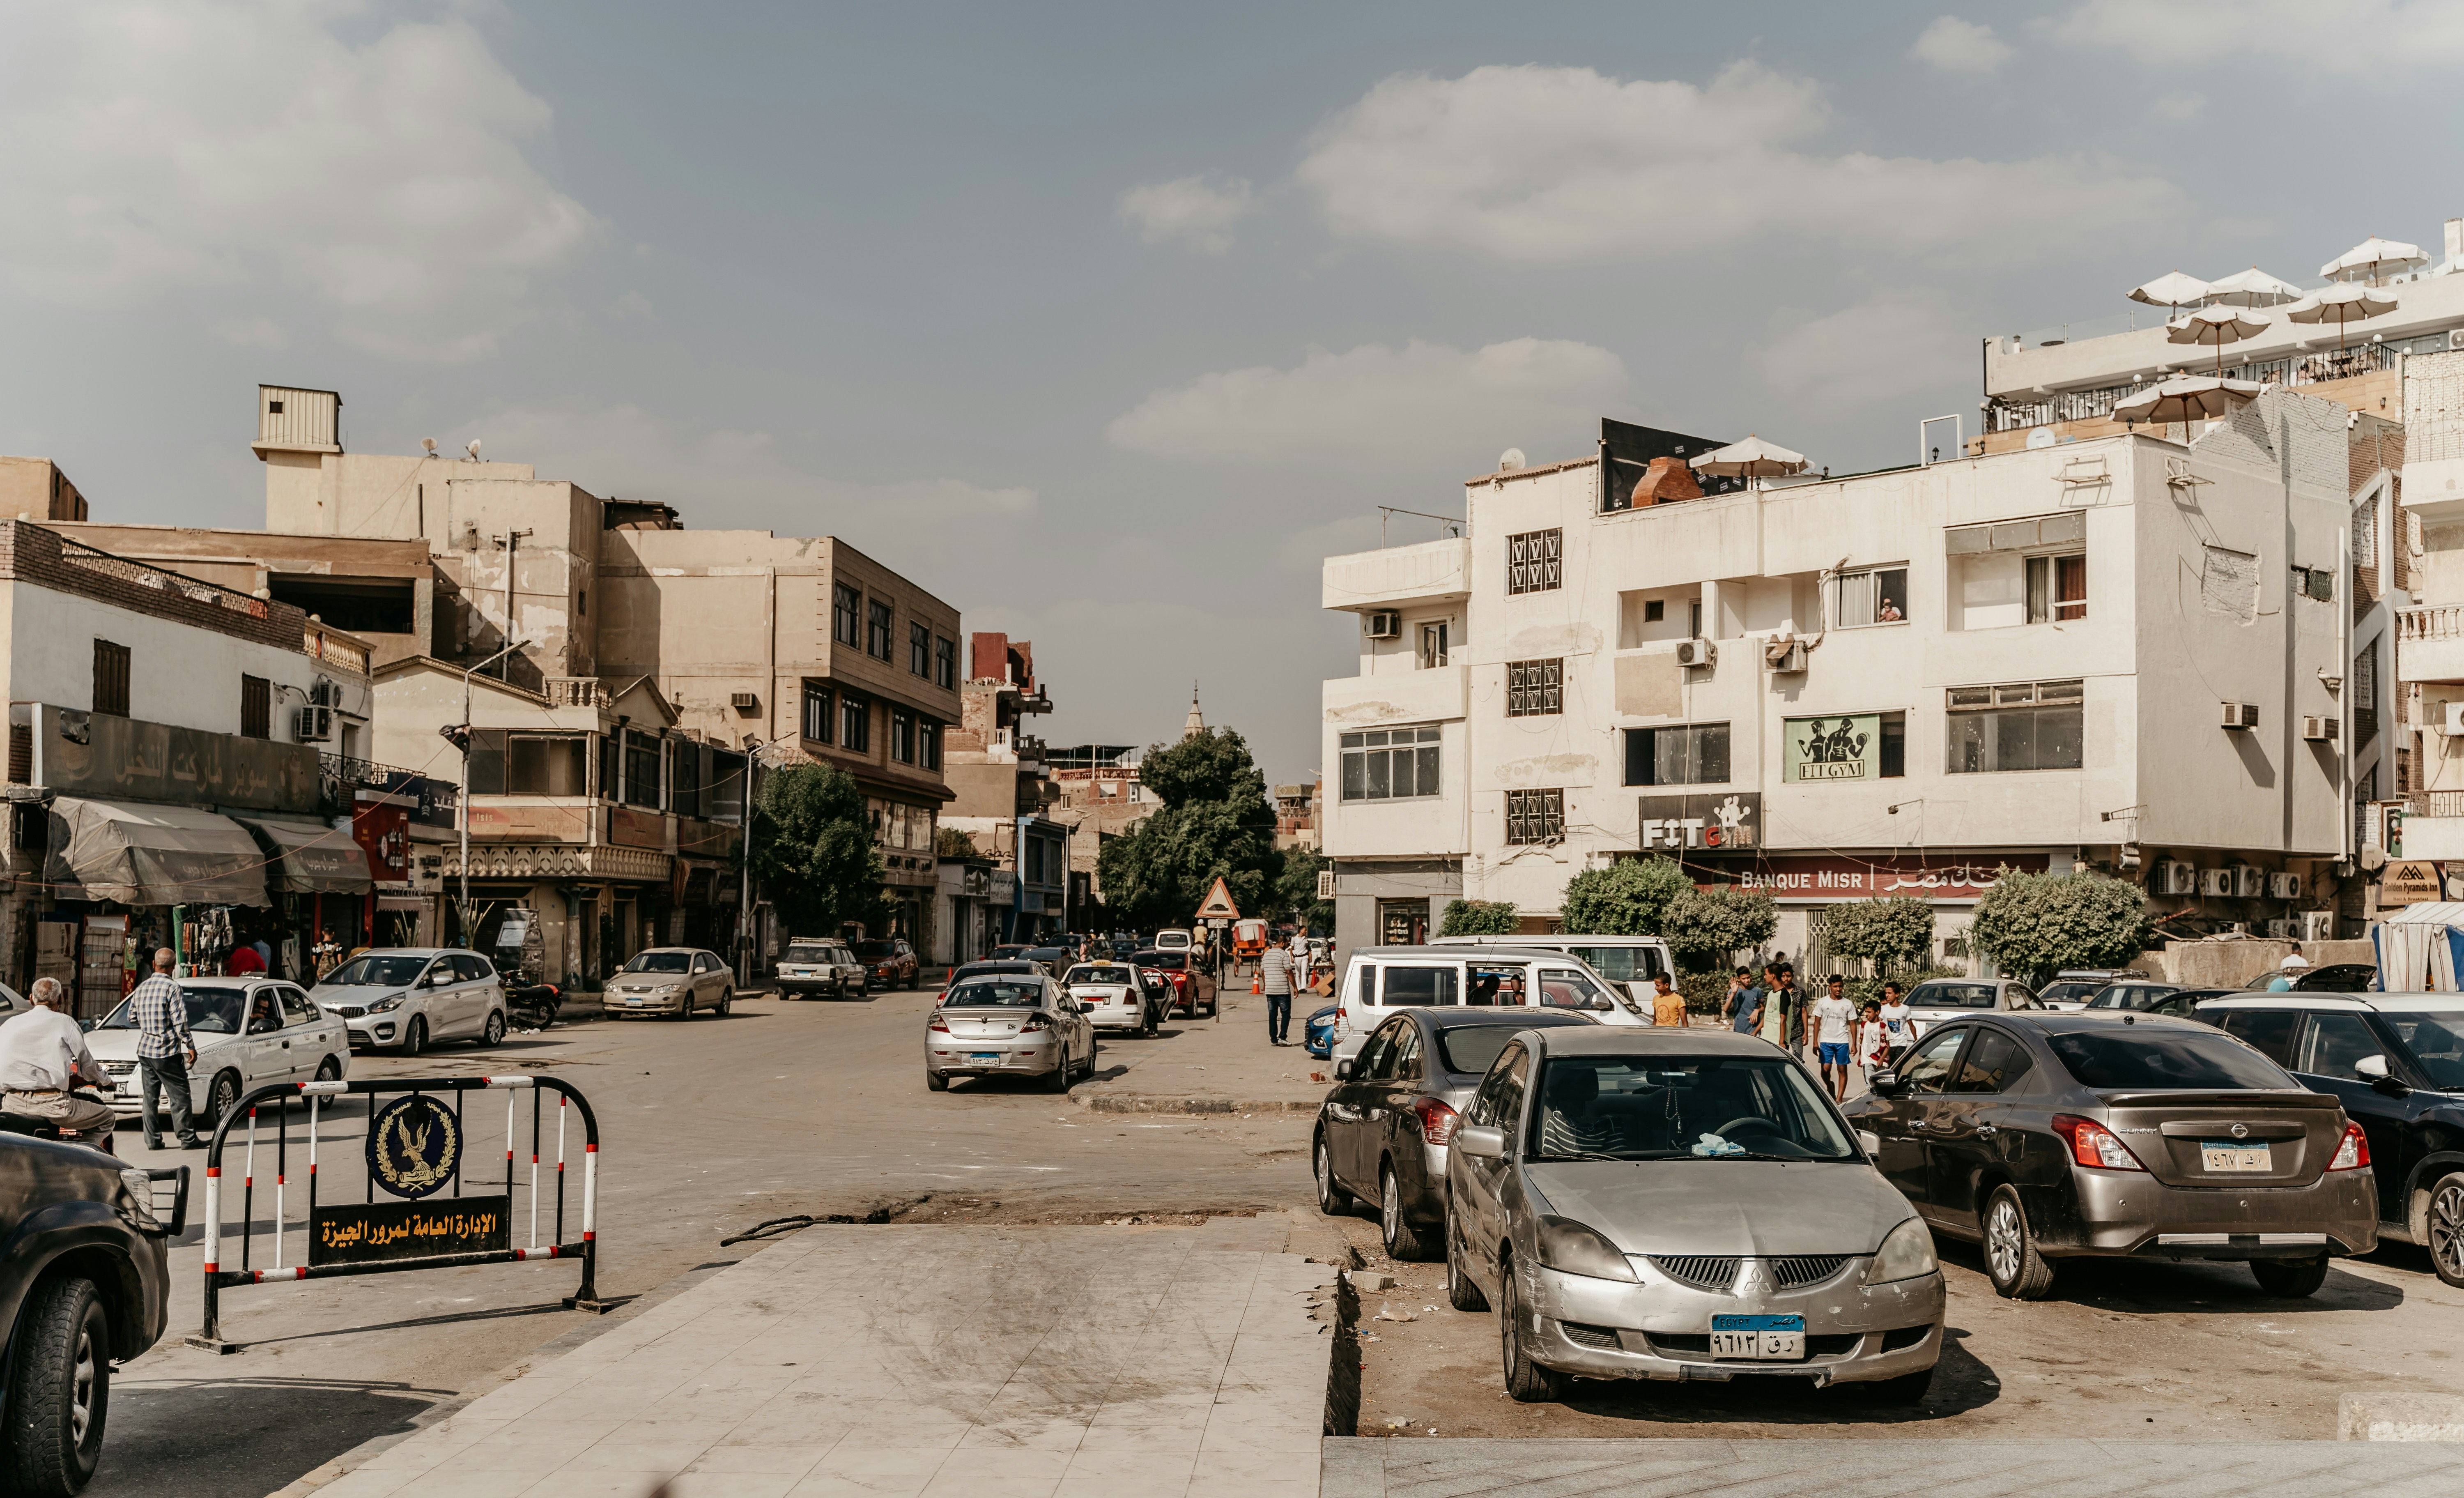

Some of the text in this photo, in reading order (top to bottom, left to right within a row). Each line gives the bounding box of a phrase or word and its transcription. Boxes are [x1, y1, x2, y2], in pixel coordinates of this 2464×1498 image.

[114, 742, 268, 797] سوبر ماركت النخيل
[1802, 762, 1862, 778] FIT GYM
[476, 813, 493, 822] Isis
[1643, 818, 1752, 848] FIT GYM
[1882, 868, 1949, 891] مصر
[2384, 881, 2438, 894] Golden Pyramids Inn
[2206, 1152, 2235, 1168] ١٤٦٧
[322, 1213, 496, 1248] الإدارة العامة لمرور الجيزة
[1719, 1317, 1750, 1328] EGYPT
[1768, 1318, 1795, 1328] مصر
[1714, 1334, 1756, 1354] ٩٦١٣
